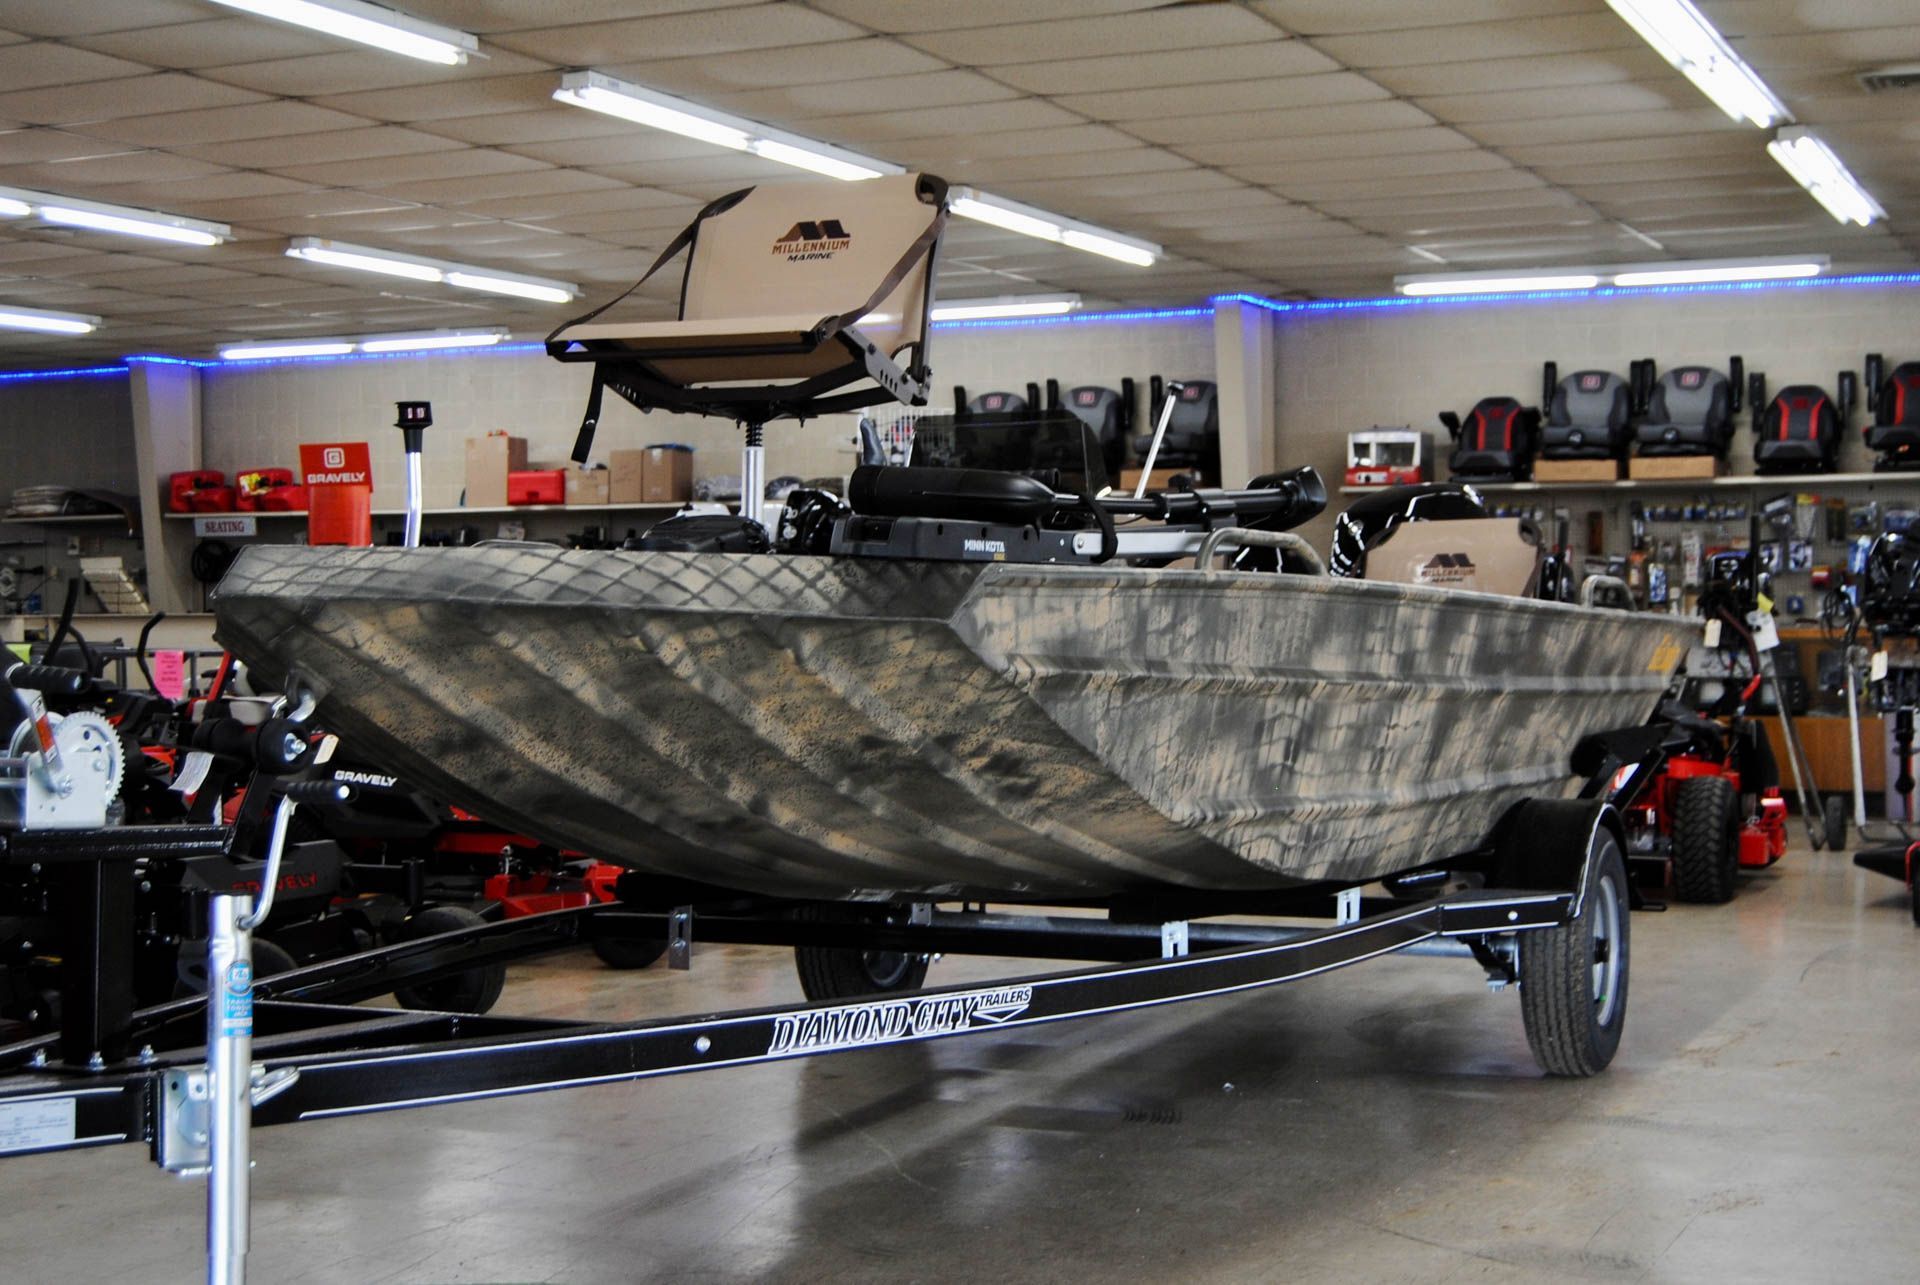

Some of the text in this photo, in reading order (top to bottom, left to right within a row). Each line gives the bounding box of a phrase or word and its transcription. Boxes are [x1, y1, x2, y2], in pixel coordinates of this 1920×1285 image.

[772, 240, 850, 255] MILLENNIUM
[787, 252, 834, 262] MARINE
[307, 471, 366, 483] GRAVELY
[204, 519, 245, 533] SEATING
[985, 540, 1006, 553] KOTA
[334, 769, 398, 787] GRAVELY
[979, 988, 1030, 1007] TRAILERS
